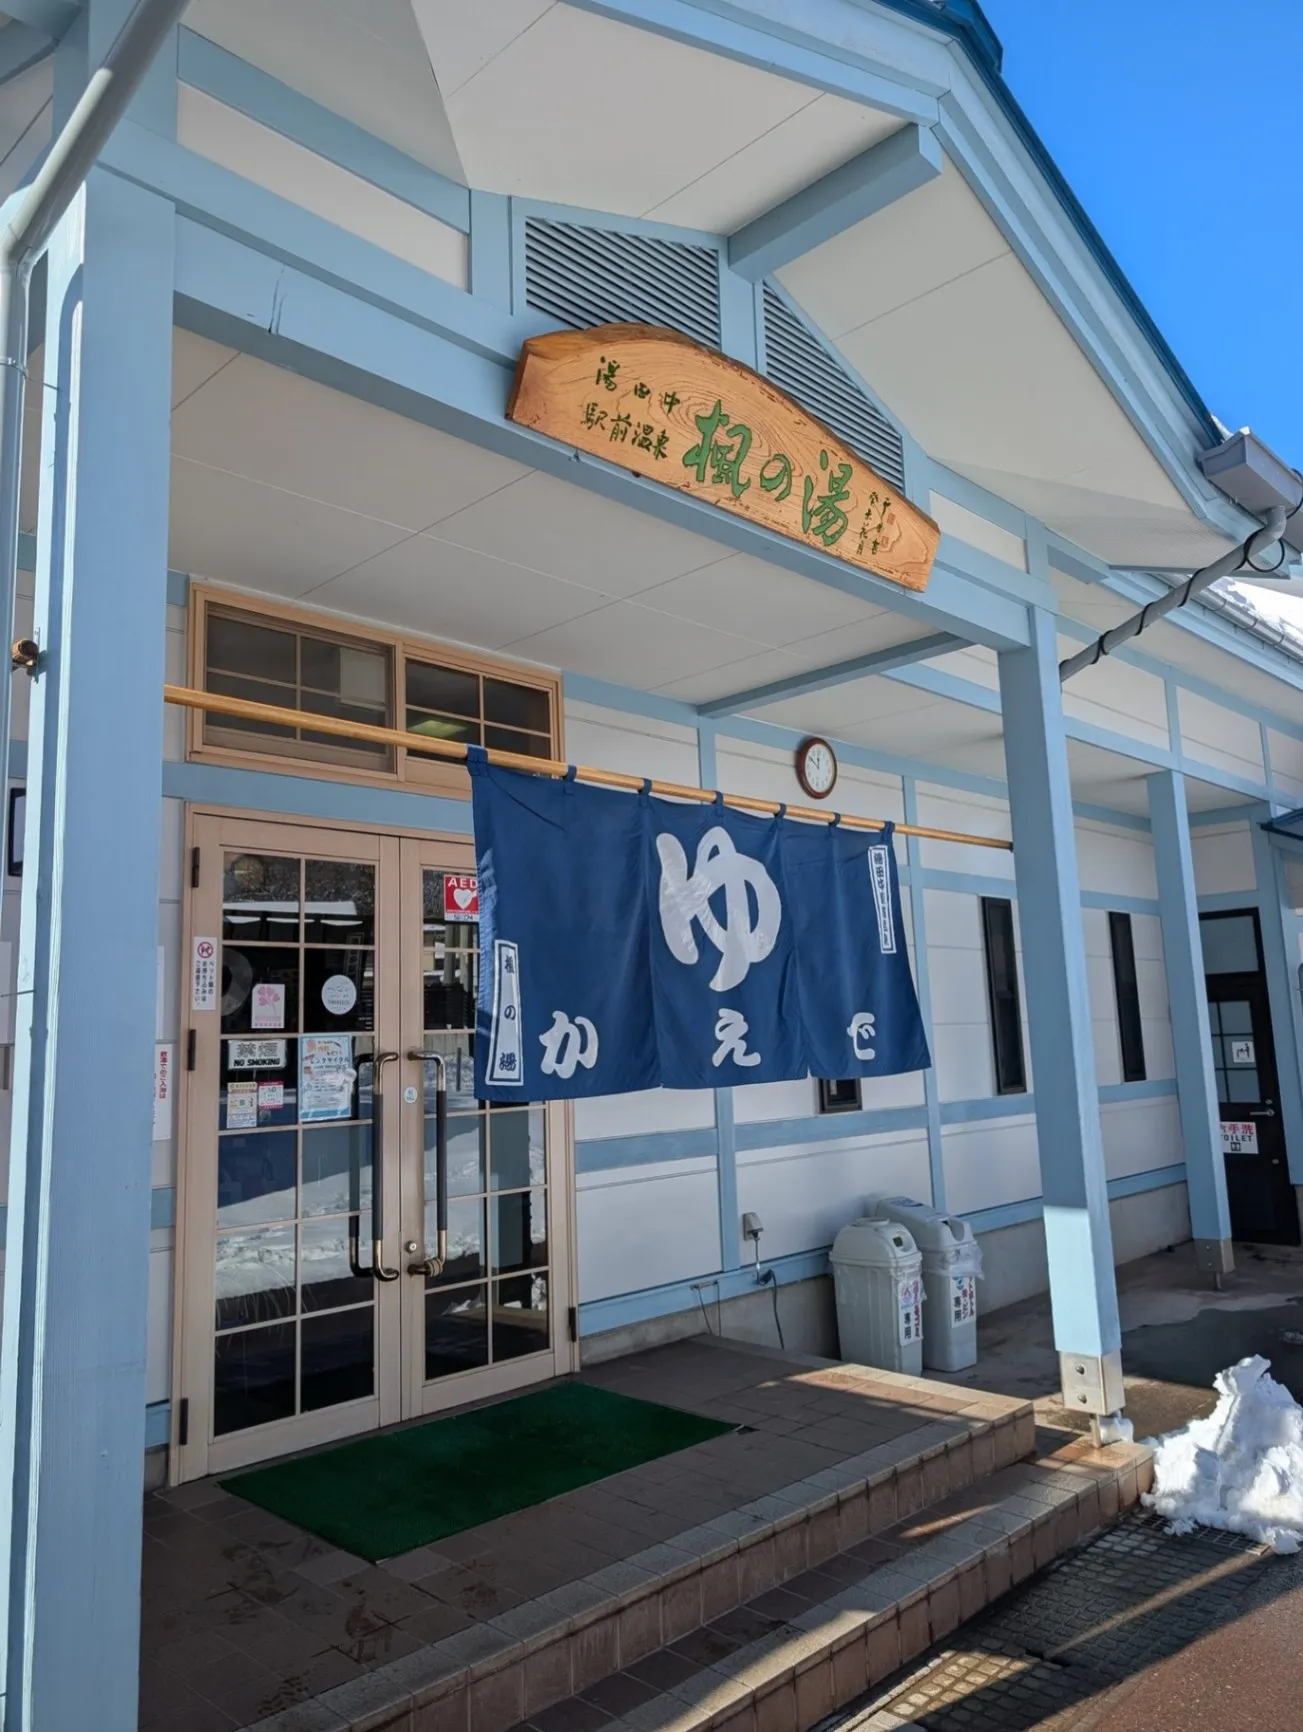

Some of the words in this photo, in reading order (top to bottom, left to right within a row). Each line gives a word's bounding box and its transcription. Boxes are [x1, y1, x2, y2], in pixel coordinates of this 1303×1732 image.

[595, 356, 681, 415] 湯田中
[580, 401, 670, 462] 駅前温泉
[682, 400, 854, 548] 楓の湯
[447, 877, 478, 889] AED
[656, 826, 781, 991] ゆ
[499, 955, 518, 1071] 楓の湯
[233, 1059, 245, 1067] NO
[247, 1058, 280, 1067] SMOKING
[236, 1042, 279, 1058] 禁煙
[1220, 1134, 1252, 1142] OILET
